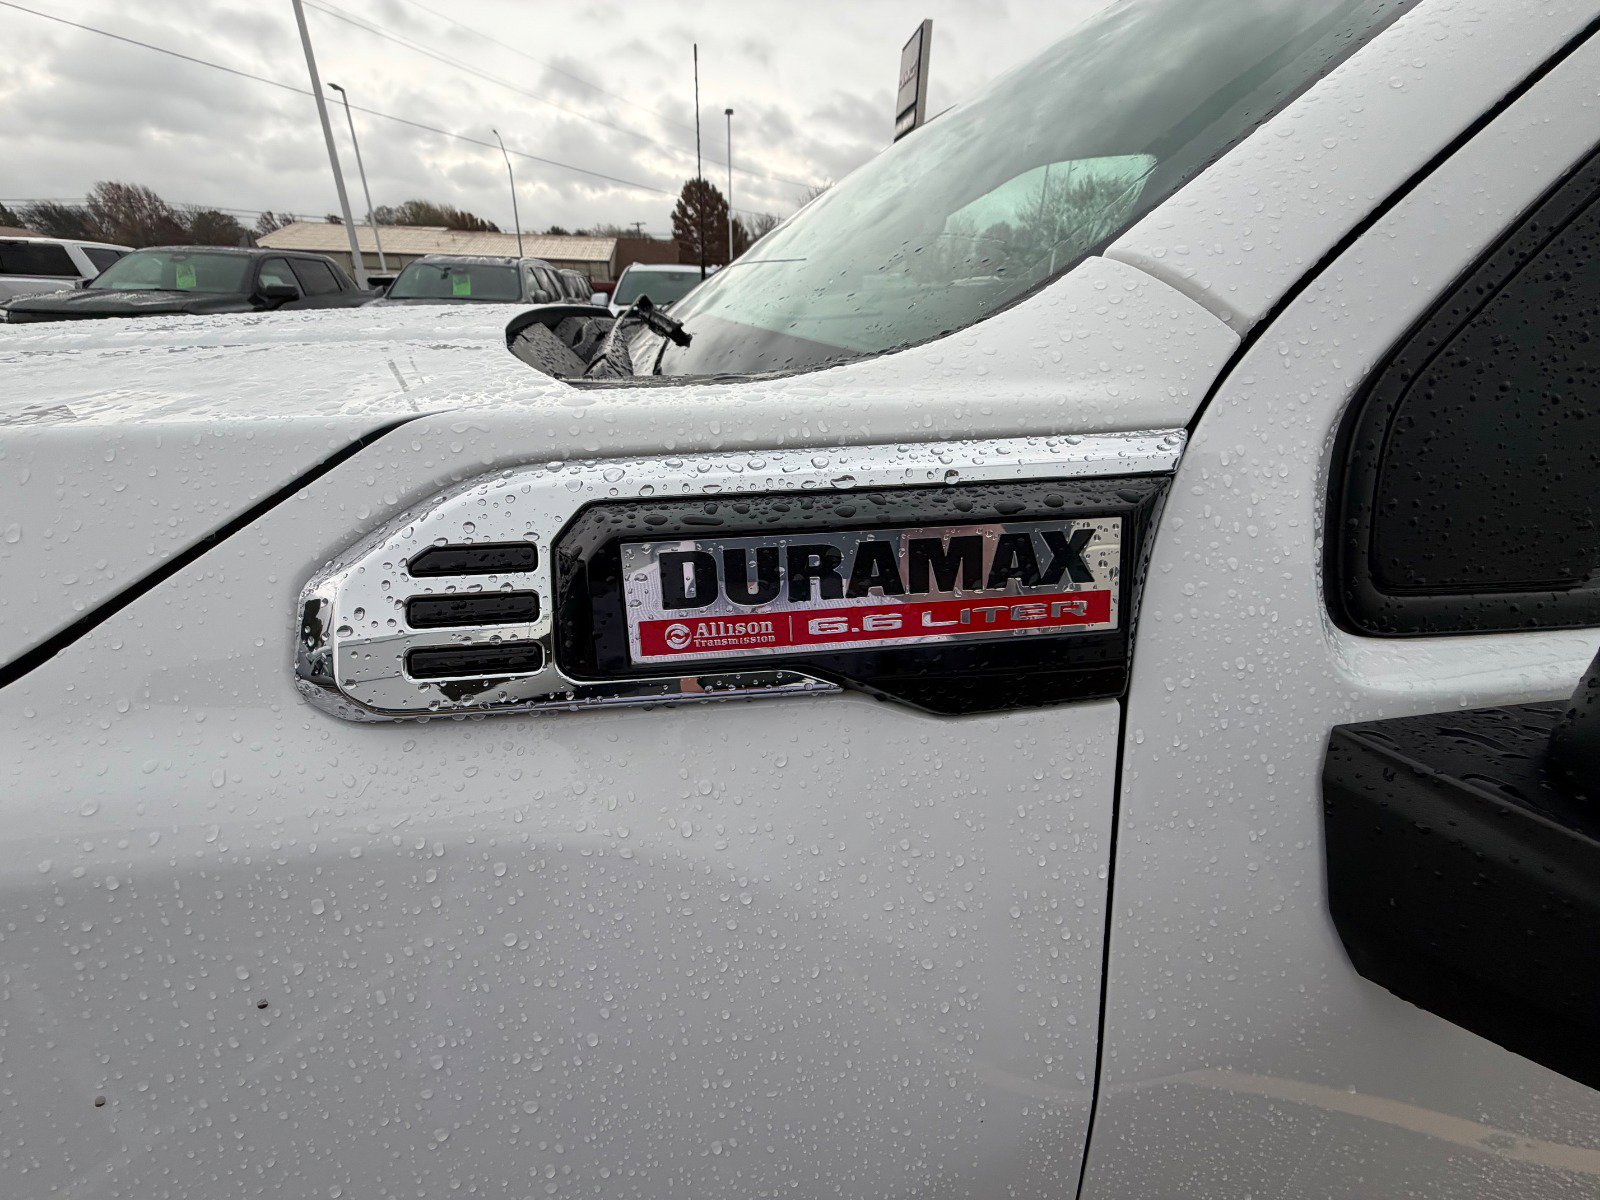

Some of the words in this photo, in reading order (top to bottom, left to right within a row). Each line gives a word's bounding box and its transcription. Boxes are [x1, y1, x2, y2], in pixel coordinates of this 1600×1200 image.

[658, 528, 1097, 610] DURAMAX
[694, 621, 774, 638] Allison
[808, 613, 903, 635] 6.6
[921, 600, 1088, 627] LITER
[694, 635, 776, 648] Transmission
